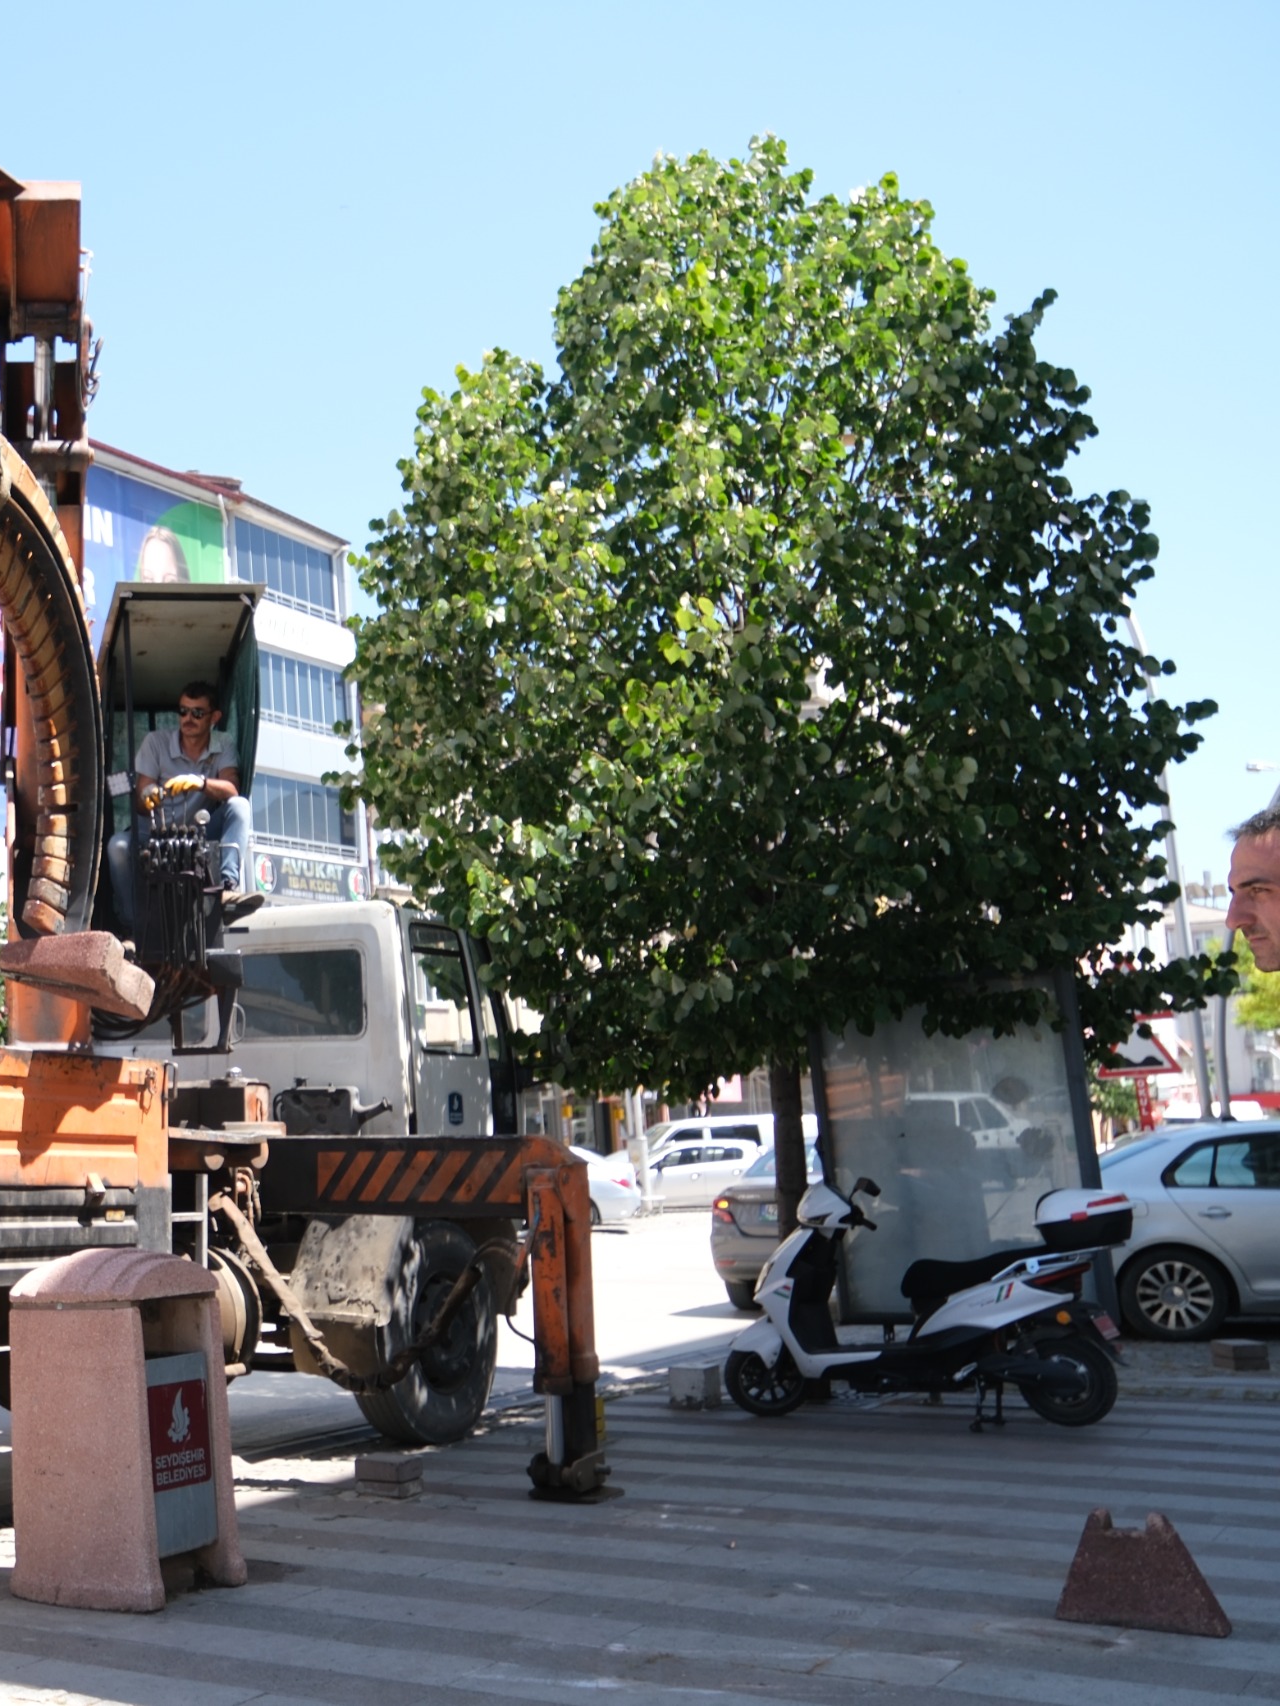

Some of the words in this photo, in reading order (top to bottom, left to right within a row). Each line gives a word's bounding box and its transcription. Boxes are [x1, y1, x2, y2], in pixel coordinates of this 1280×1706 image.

[282, 857, 343, 881] AVUKAT
[156, 1448, 204, 1469] SEYDİŞEHİR
[157, 1463, 206, 1485] BELEDİYESİ
